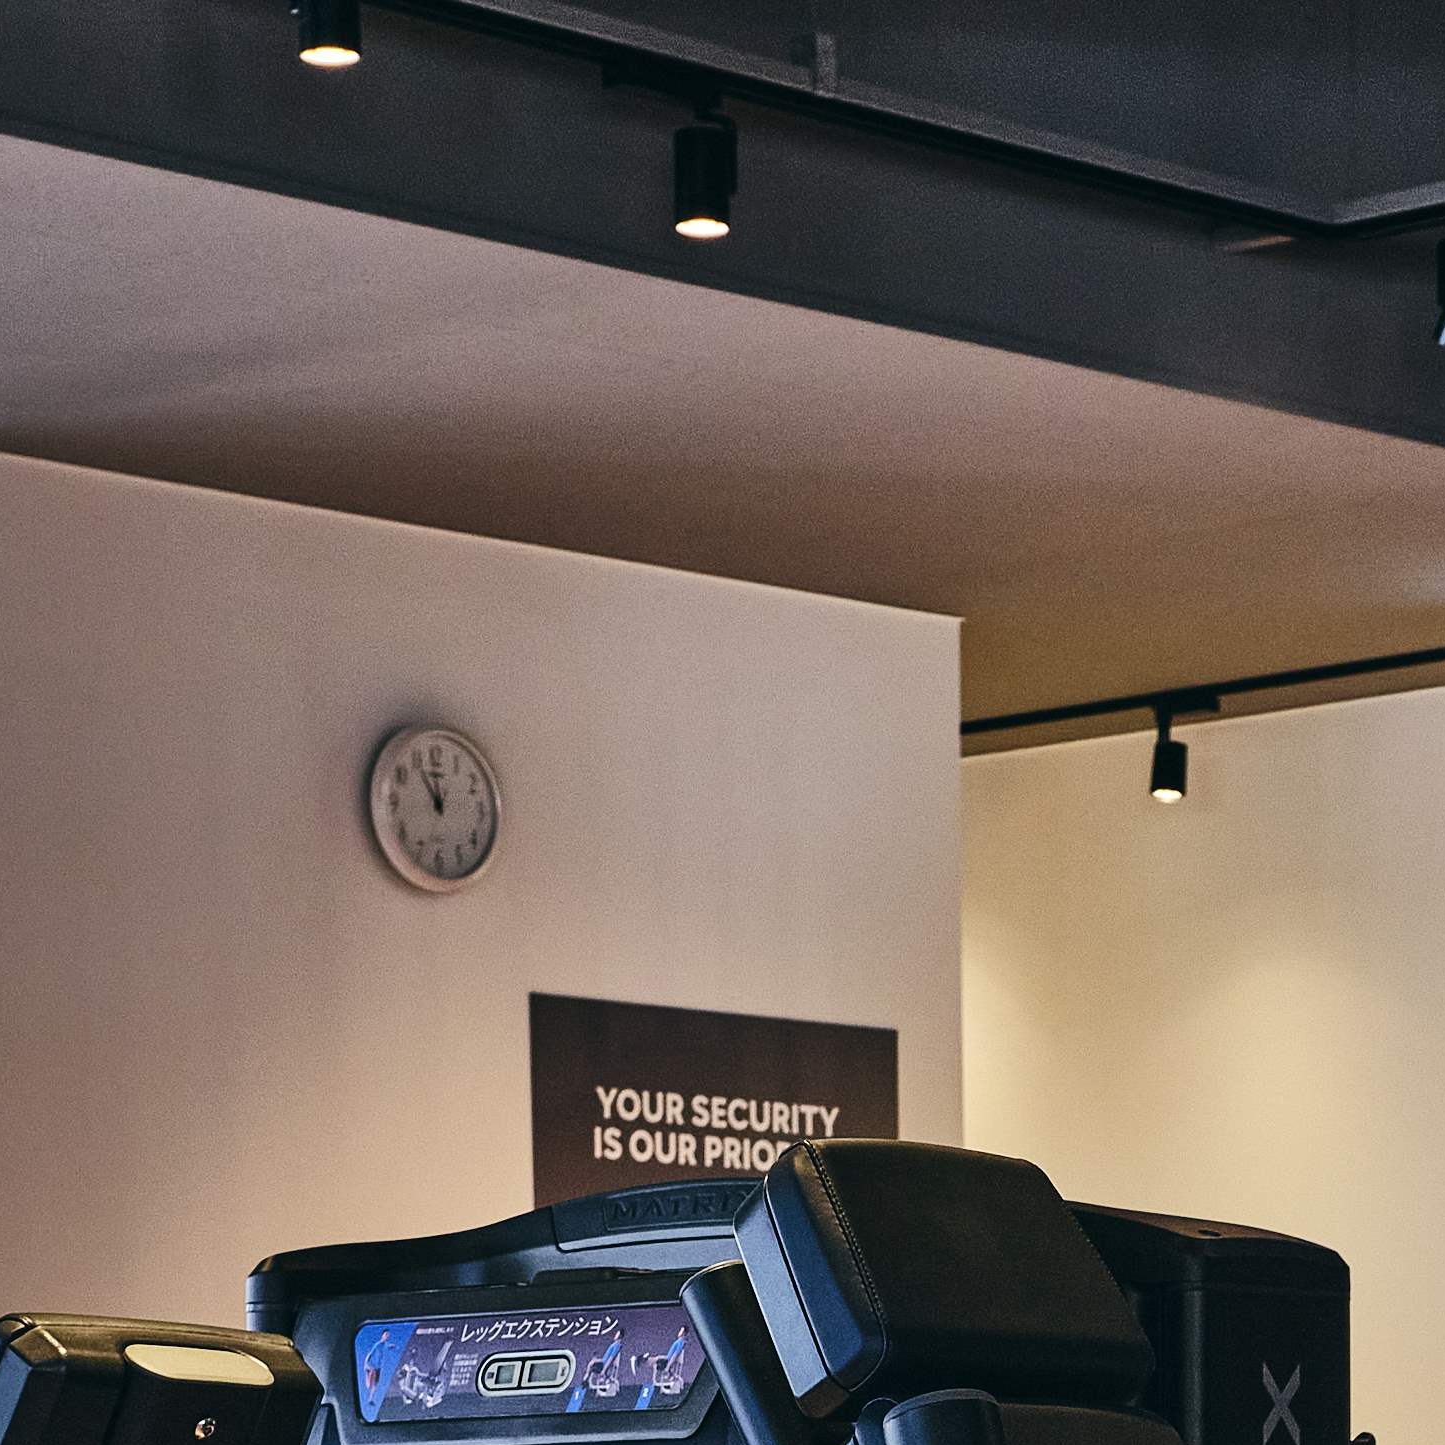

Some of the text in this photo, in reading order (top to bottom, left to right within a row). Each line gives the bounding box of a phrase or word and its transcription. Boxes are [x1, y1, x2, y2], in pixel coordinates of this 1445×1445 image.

[596, 1085, 840, 1137] YOUR SECURITY
[593, 1126, 623, 1160] IS
[628, 1129, 697, 1167] OUR
[613, 1190, 749, 1220] MATRI
[460, 1316, 619, 1344] レッグエクステンション
